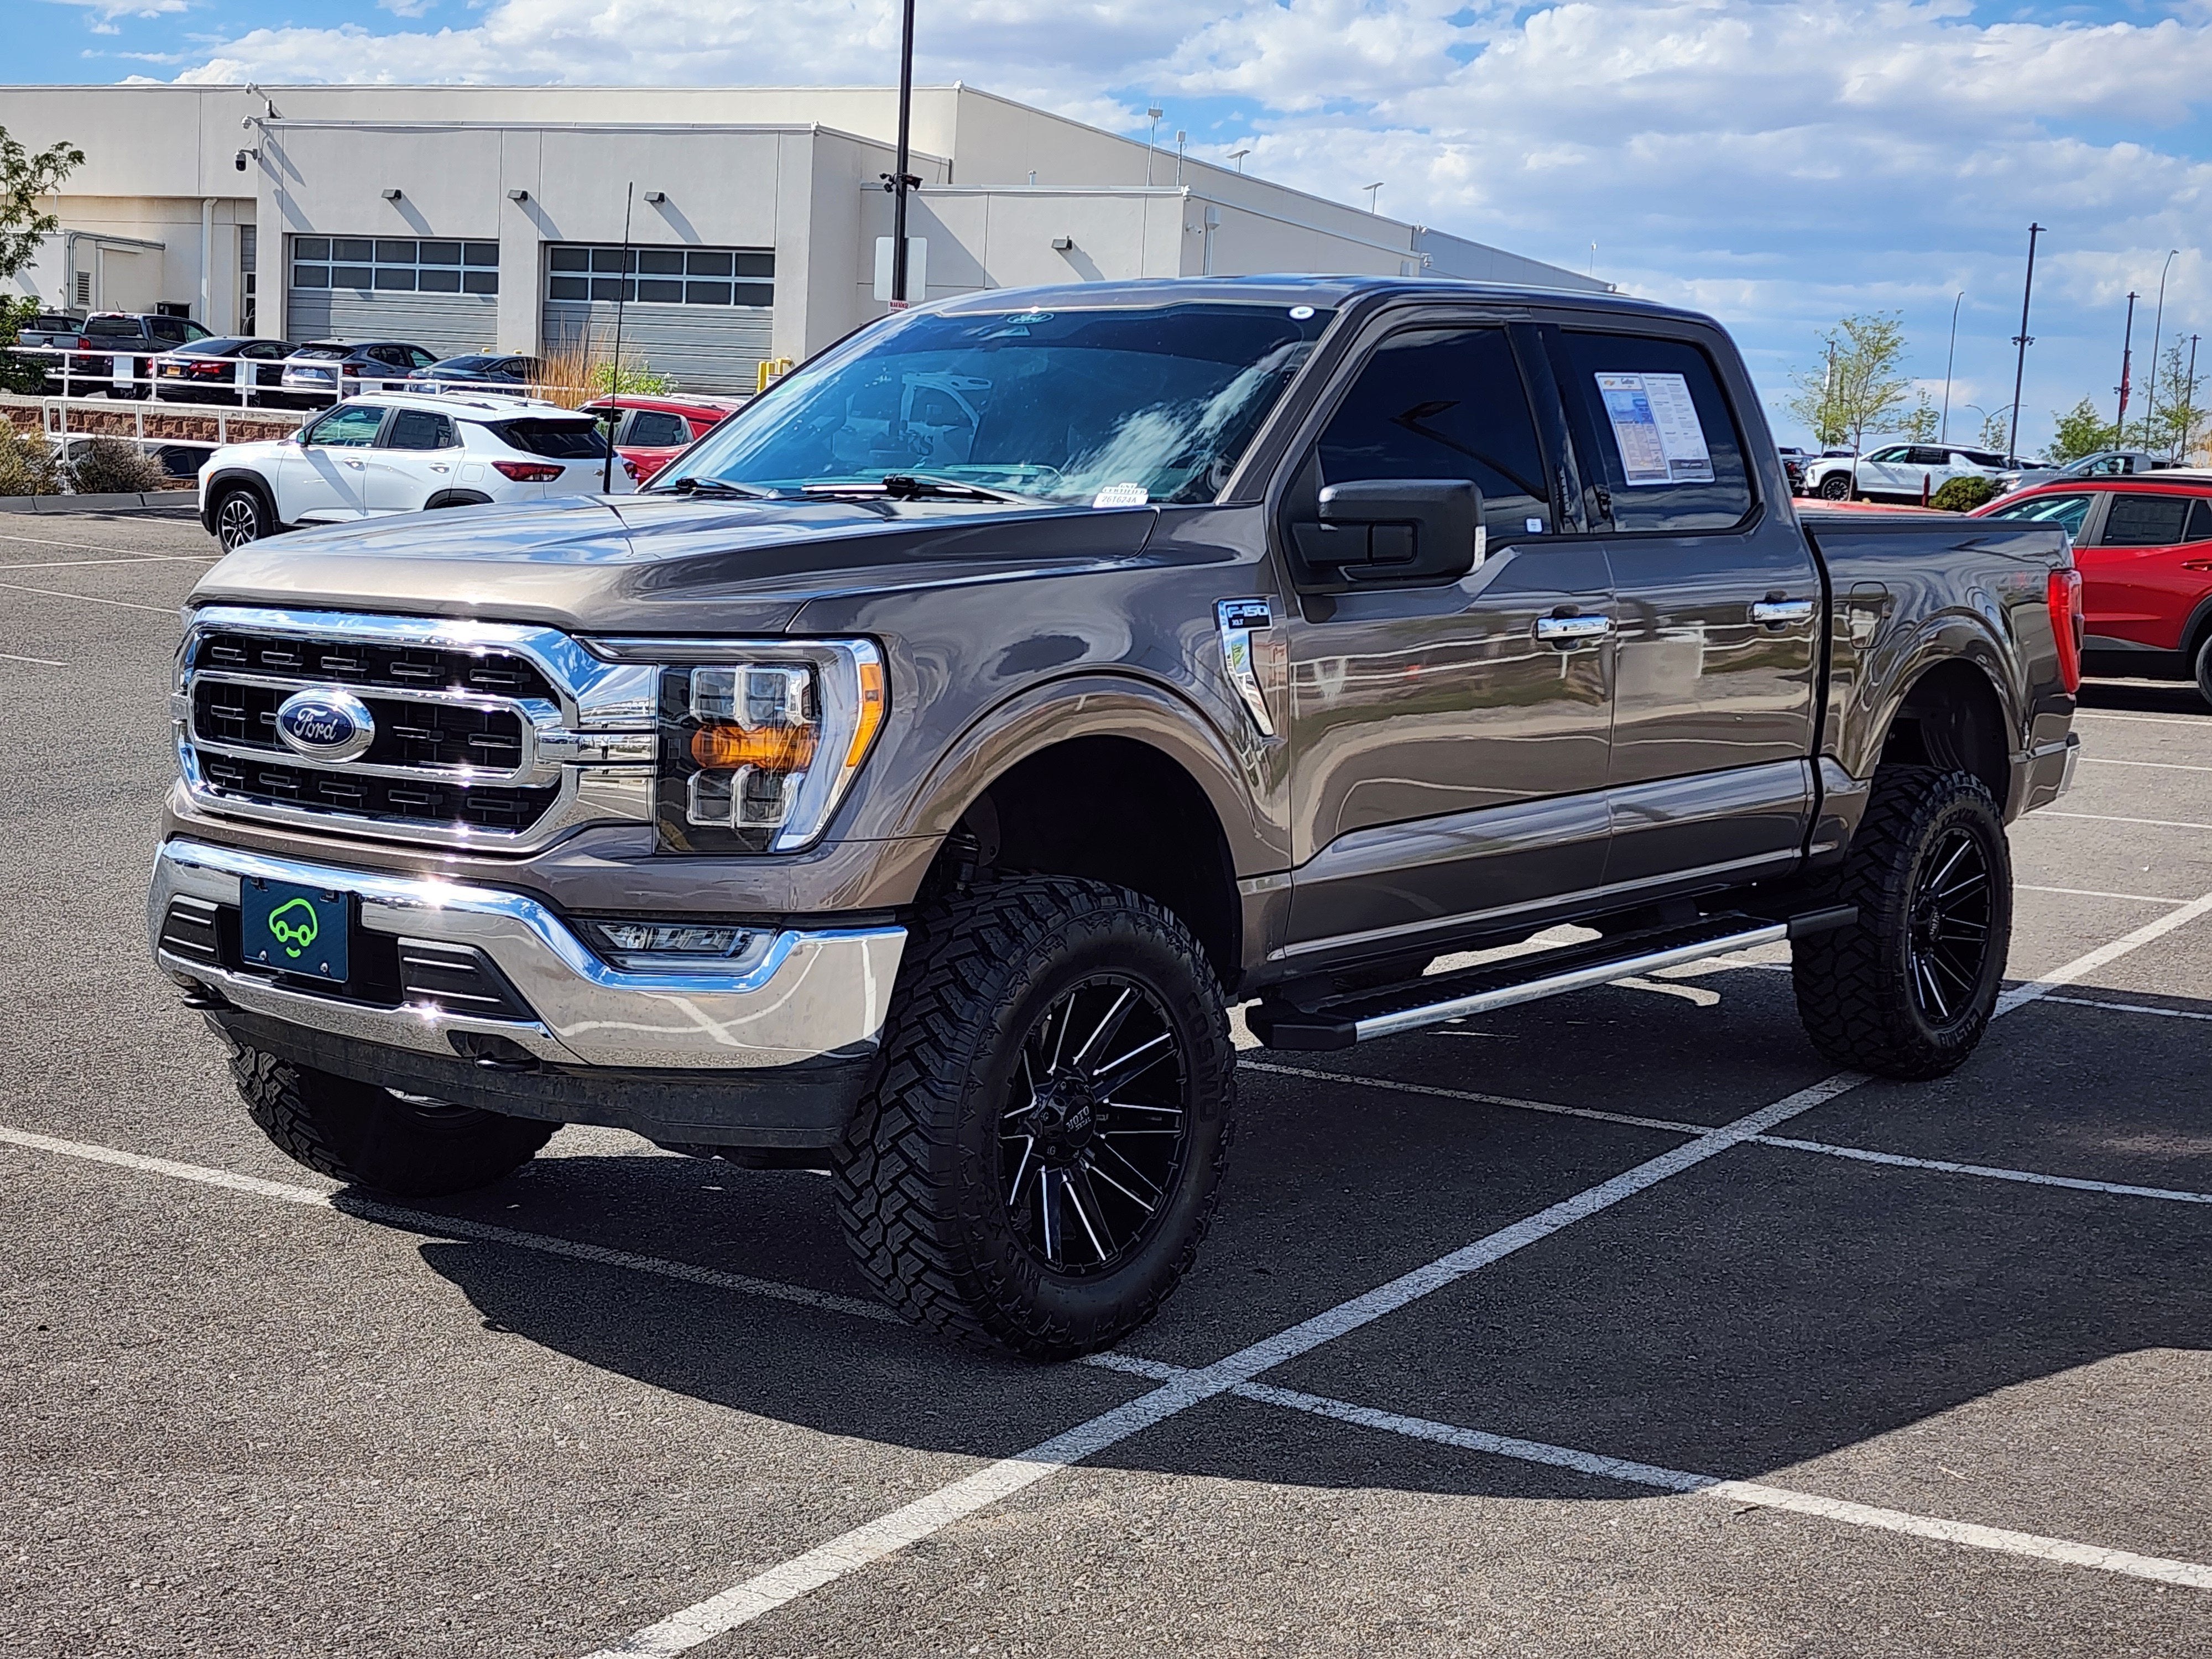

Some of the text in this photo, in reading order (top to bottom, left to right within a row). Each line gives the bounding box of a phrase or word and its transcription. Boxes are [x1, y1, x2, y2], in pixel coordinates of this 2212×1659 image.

[1227, 605, 1269, 618] F-150
[293, 708, 338, 740] Ford
[1181, 991, 1218, 1123] COSMO
